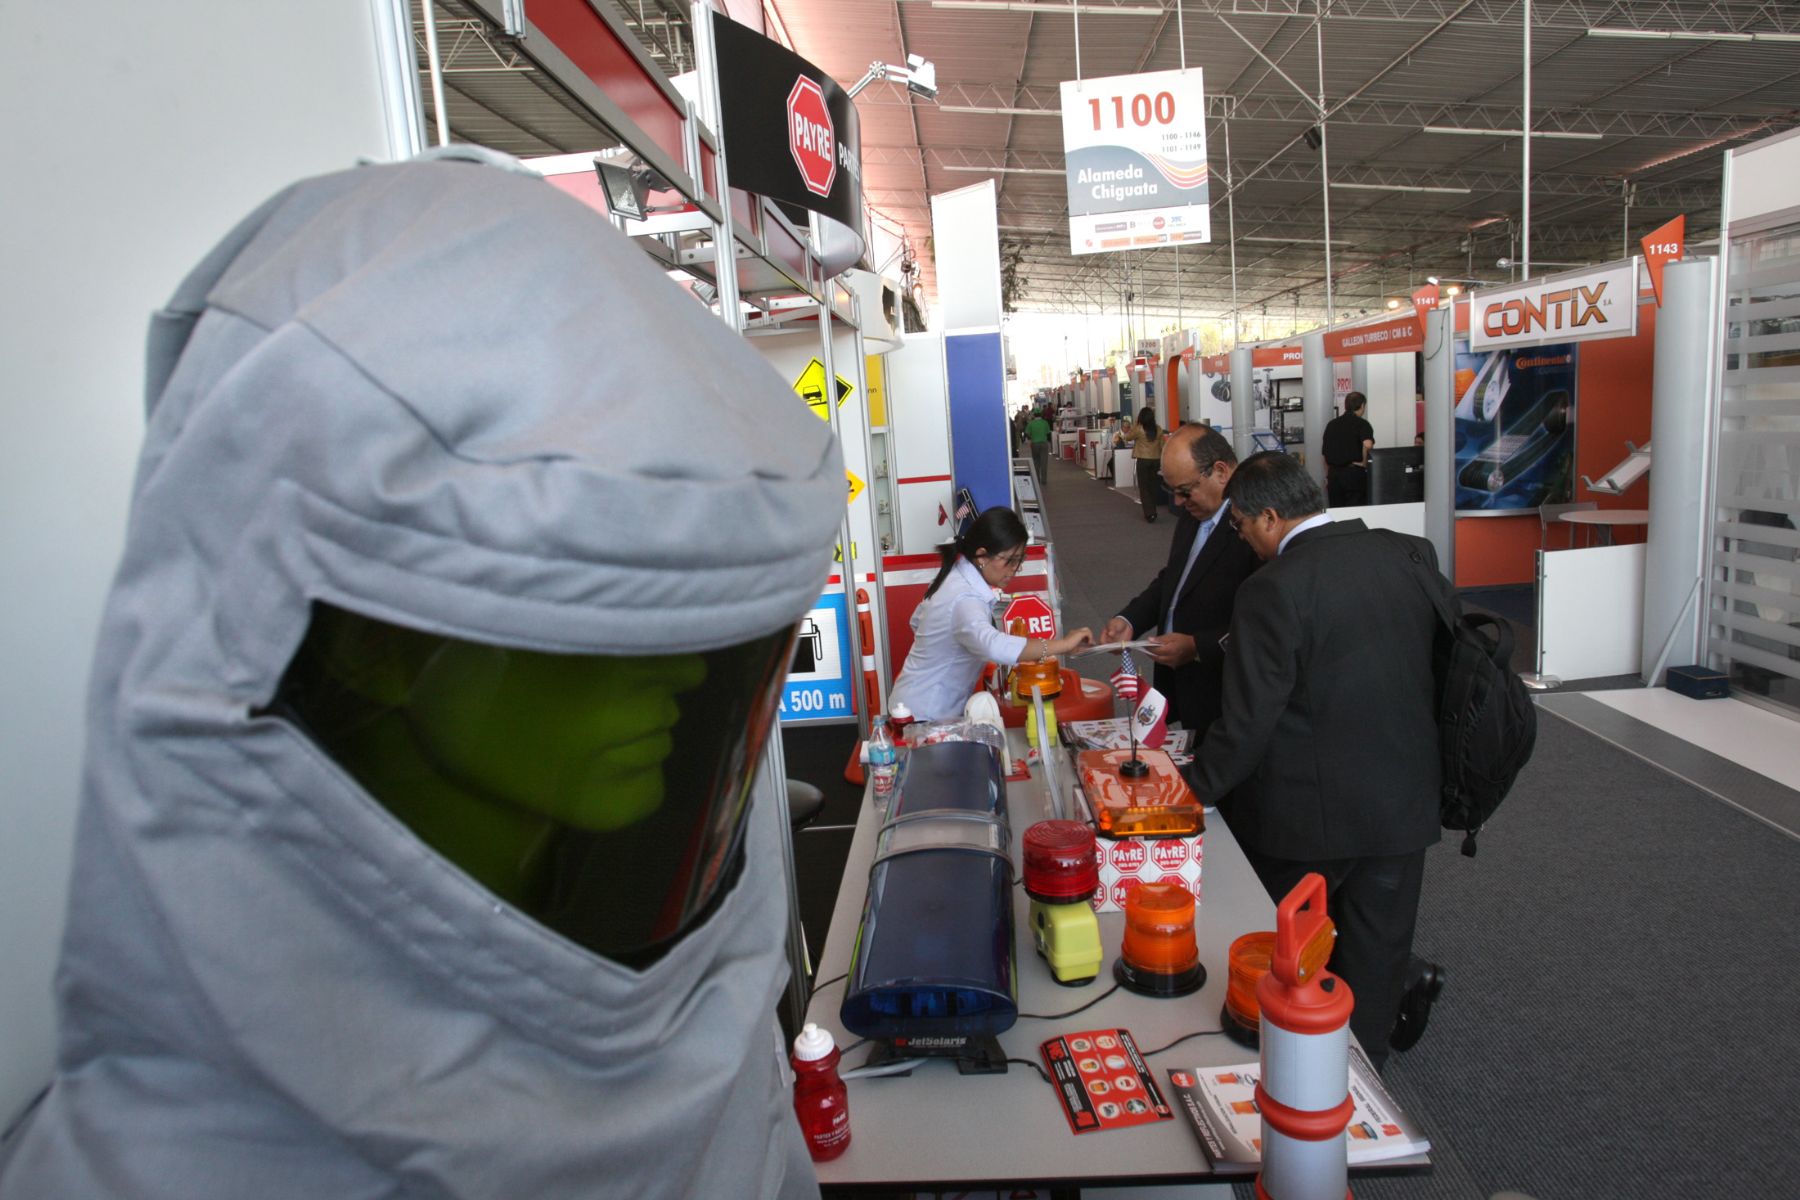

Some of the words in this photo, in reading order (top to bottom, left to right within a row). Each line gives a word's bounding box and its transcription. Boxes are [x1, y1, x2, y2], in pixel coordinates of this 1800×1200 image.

[1088, 91, 1175, 131] 1100
[795, 111, 831, 162] PAYRE
[1162, 133, 1178, 141] 1100
[1077, 164, 1143, 184] Alameda
[1091, 183, 1158, 201] Chiguata
[1649, 243, 1678, 255] 1143
[1416, 297, 1435, 305] 1141
[1484, 280, 1609, 338] CONTIX
[791, 689, 823, 712] 500
[829, 692, 845, 709] m
[1112, 850, 1143, 861] PAYRE
[1154, 846, 1186, 859] PAYRE
[908, 1036, 967, 1046] JetSolaris
